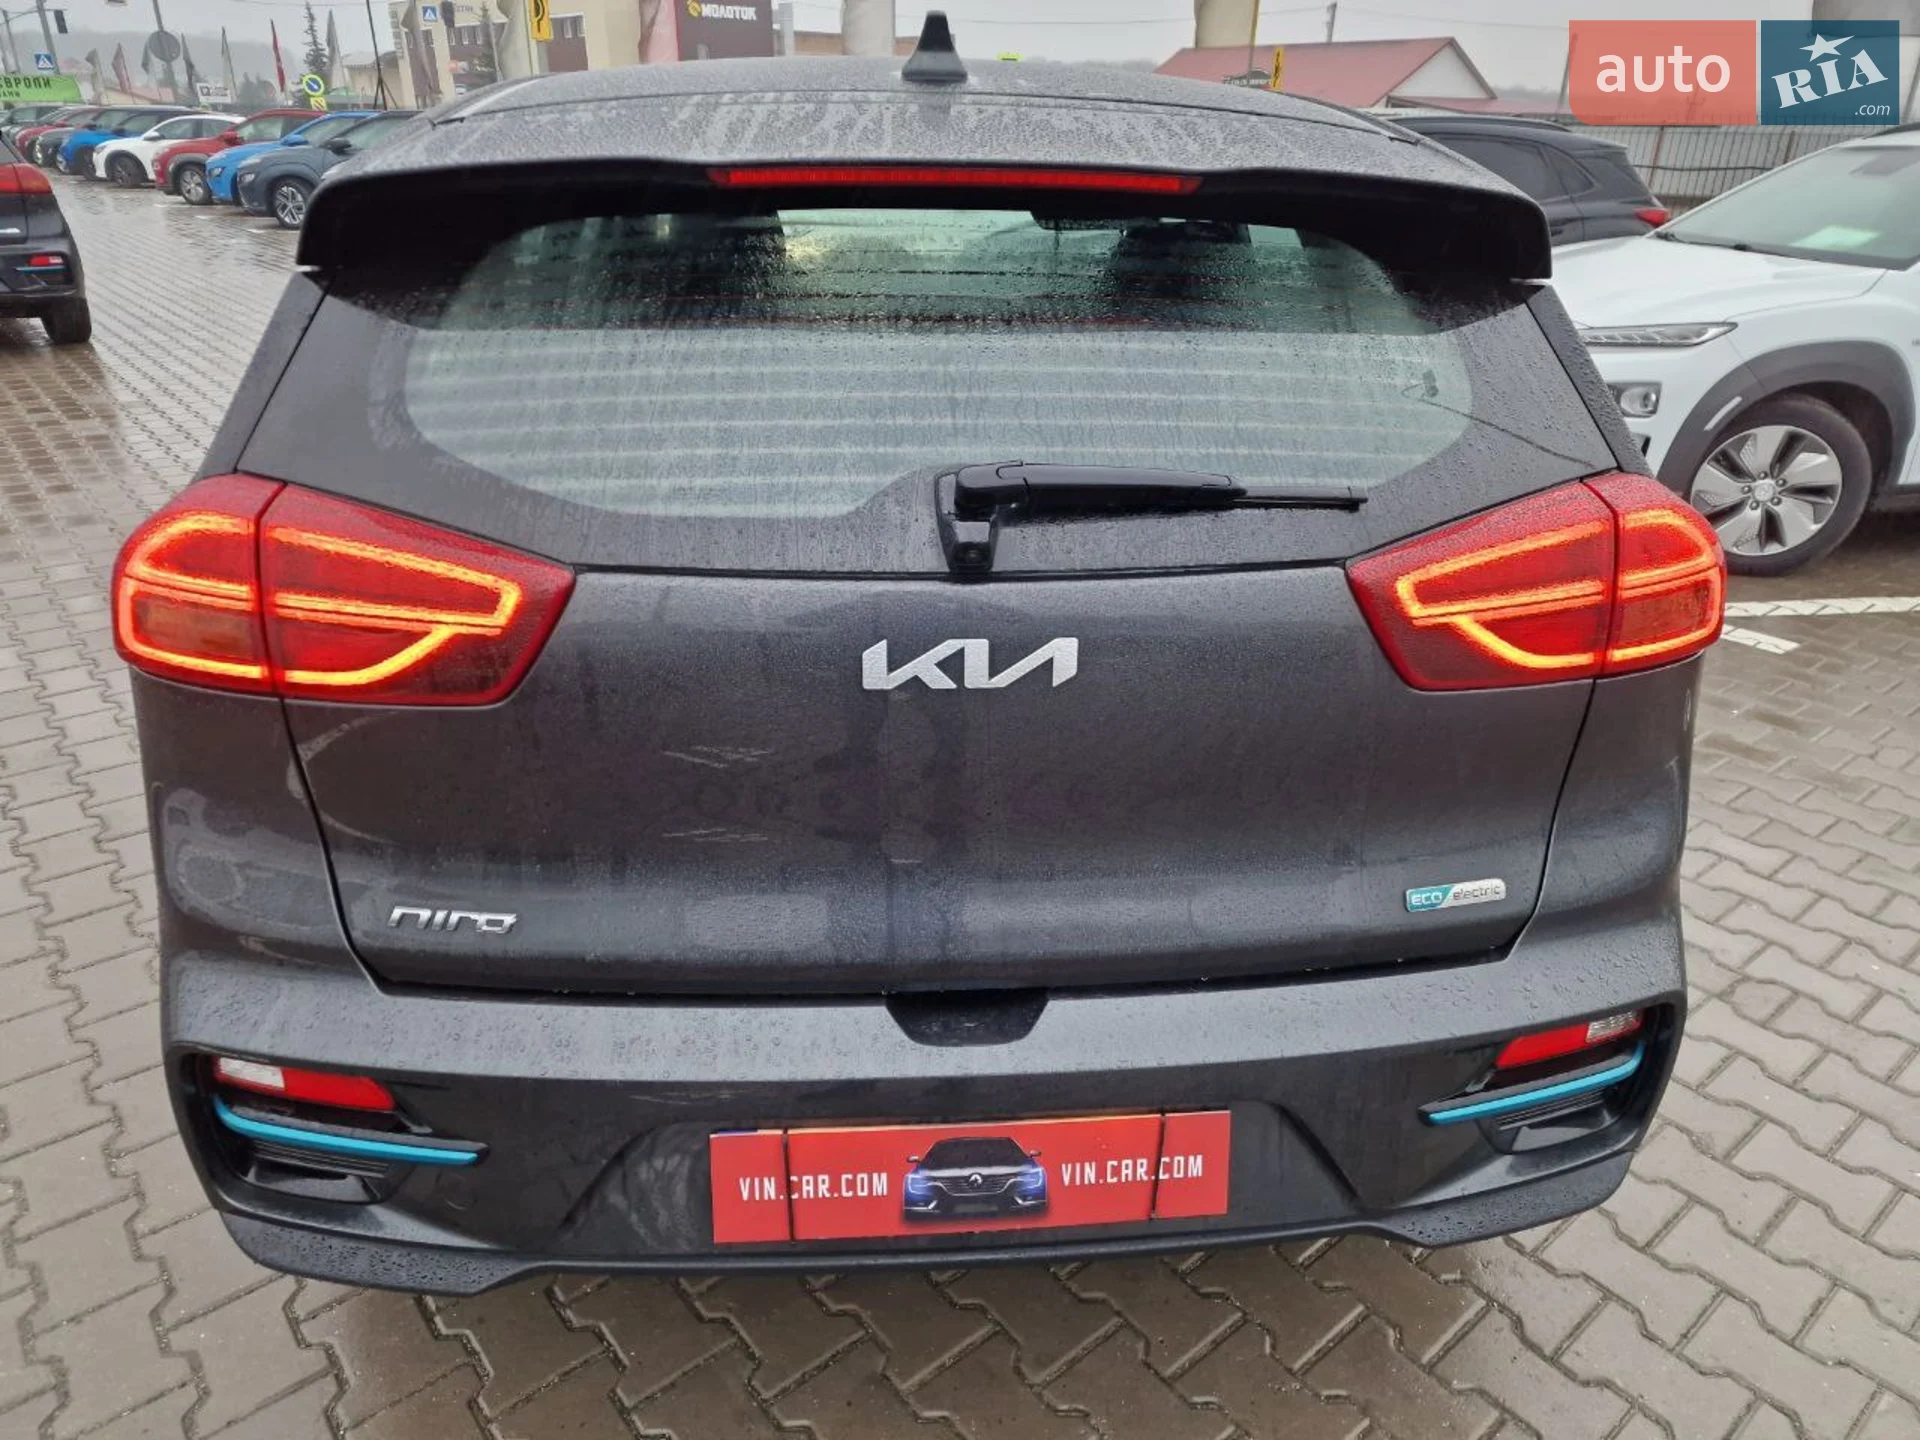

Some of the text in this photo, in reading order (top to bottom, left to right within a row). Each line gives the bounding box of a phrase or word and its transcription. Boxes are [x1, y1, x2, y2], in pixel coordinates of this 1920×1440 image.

[701, 4, 757, 20] МОЛОТОК
[862, 637, 1079, 690] KIA
[1411, 884, 1500, 905] ECO electric
[1061, 1154, 1203, 1187] VIN.CAR.COM
